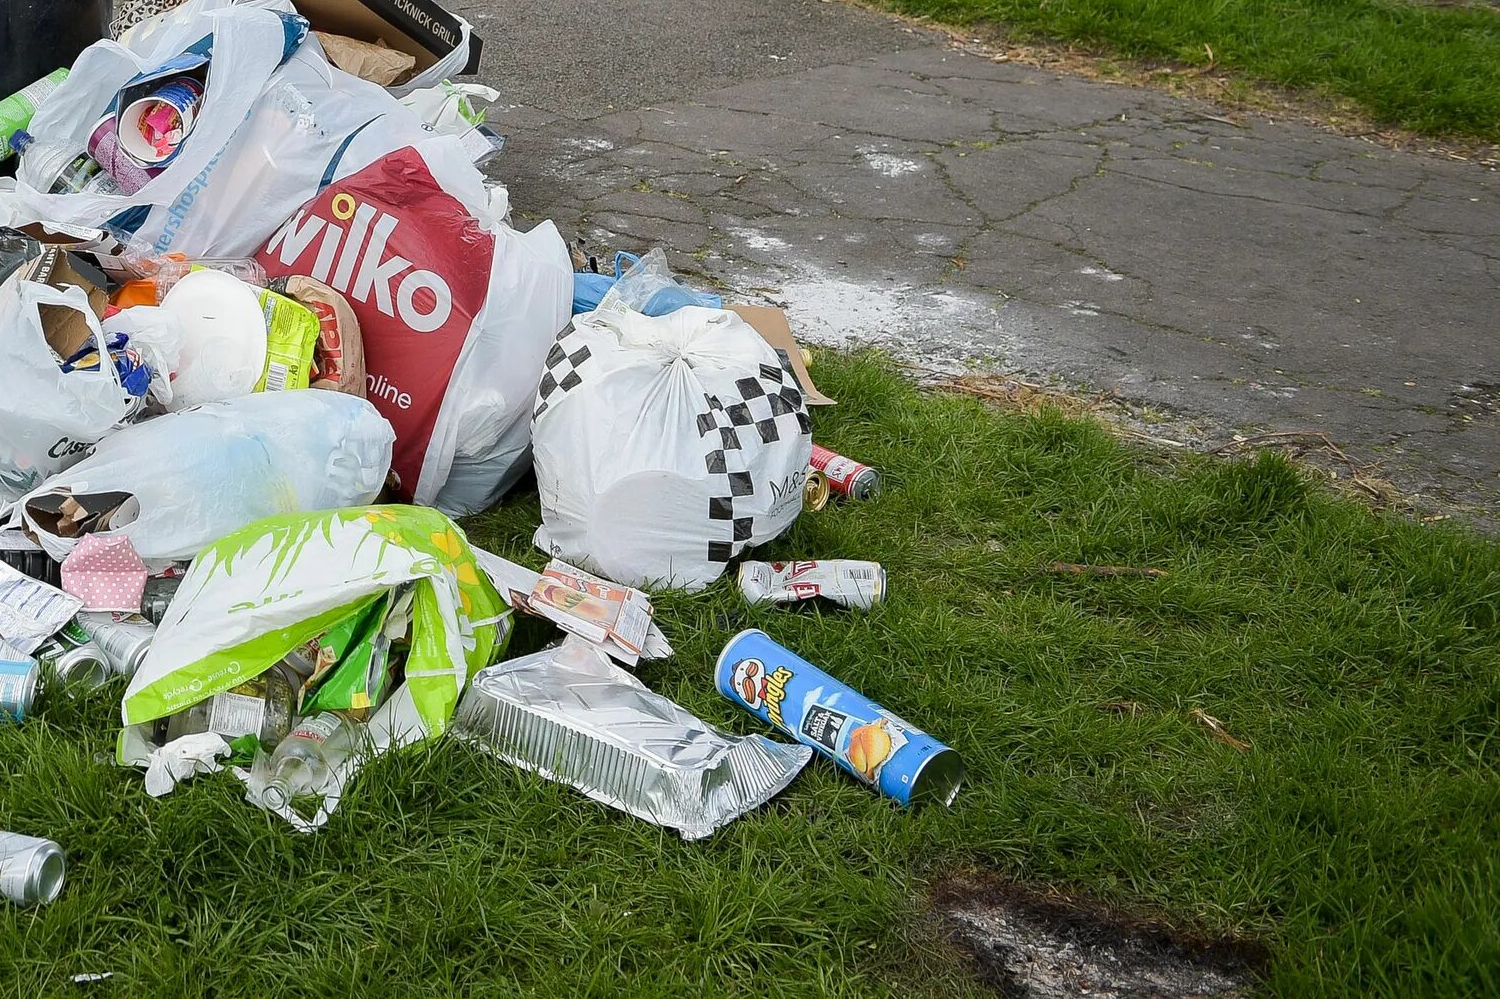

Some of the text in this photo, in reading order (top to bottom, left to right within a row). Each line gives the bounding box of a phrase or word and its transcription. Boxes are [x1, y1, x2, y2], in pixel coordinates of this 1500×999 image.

[431, 20, 457, 49] GRILL
[266, 192, 452, 333] wilko
[366, 373, 412, 409] nline
[810, 715, 820, 738] SALT
